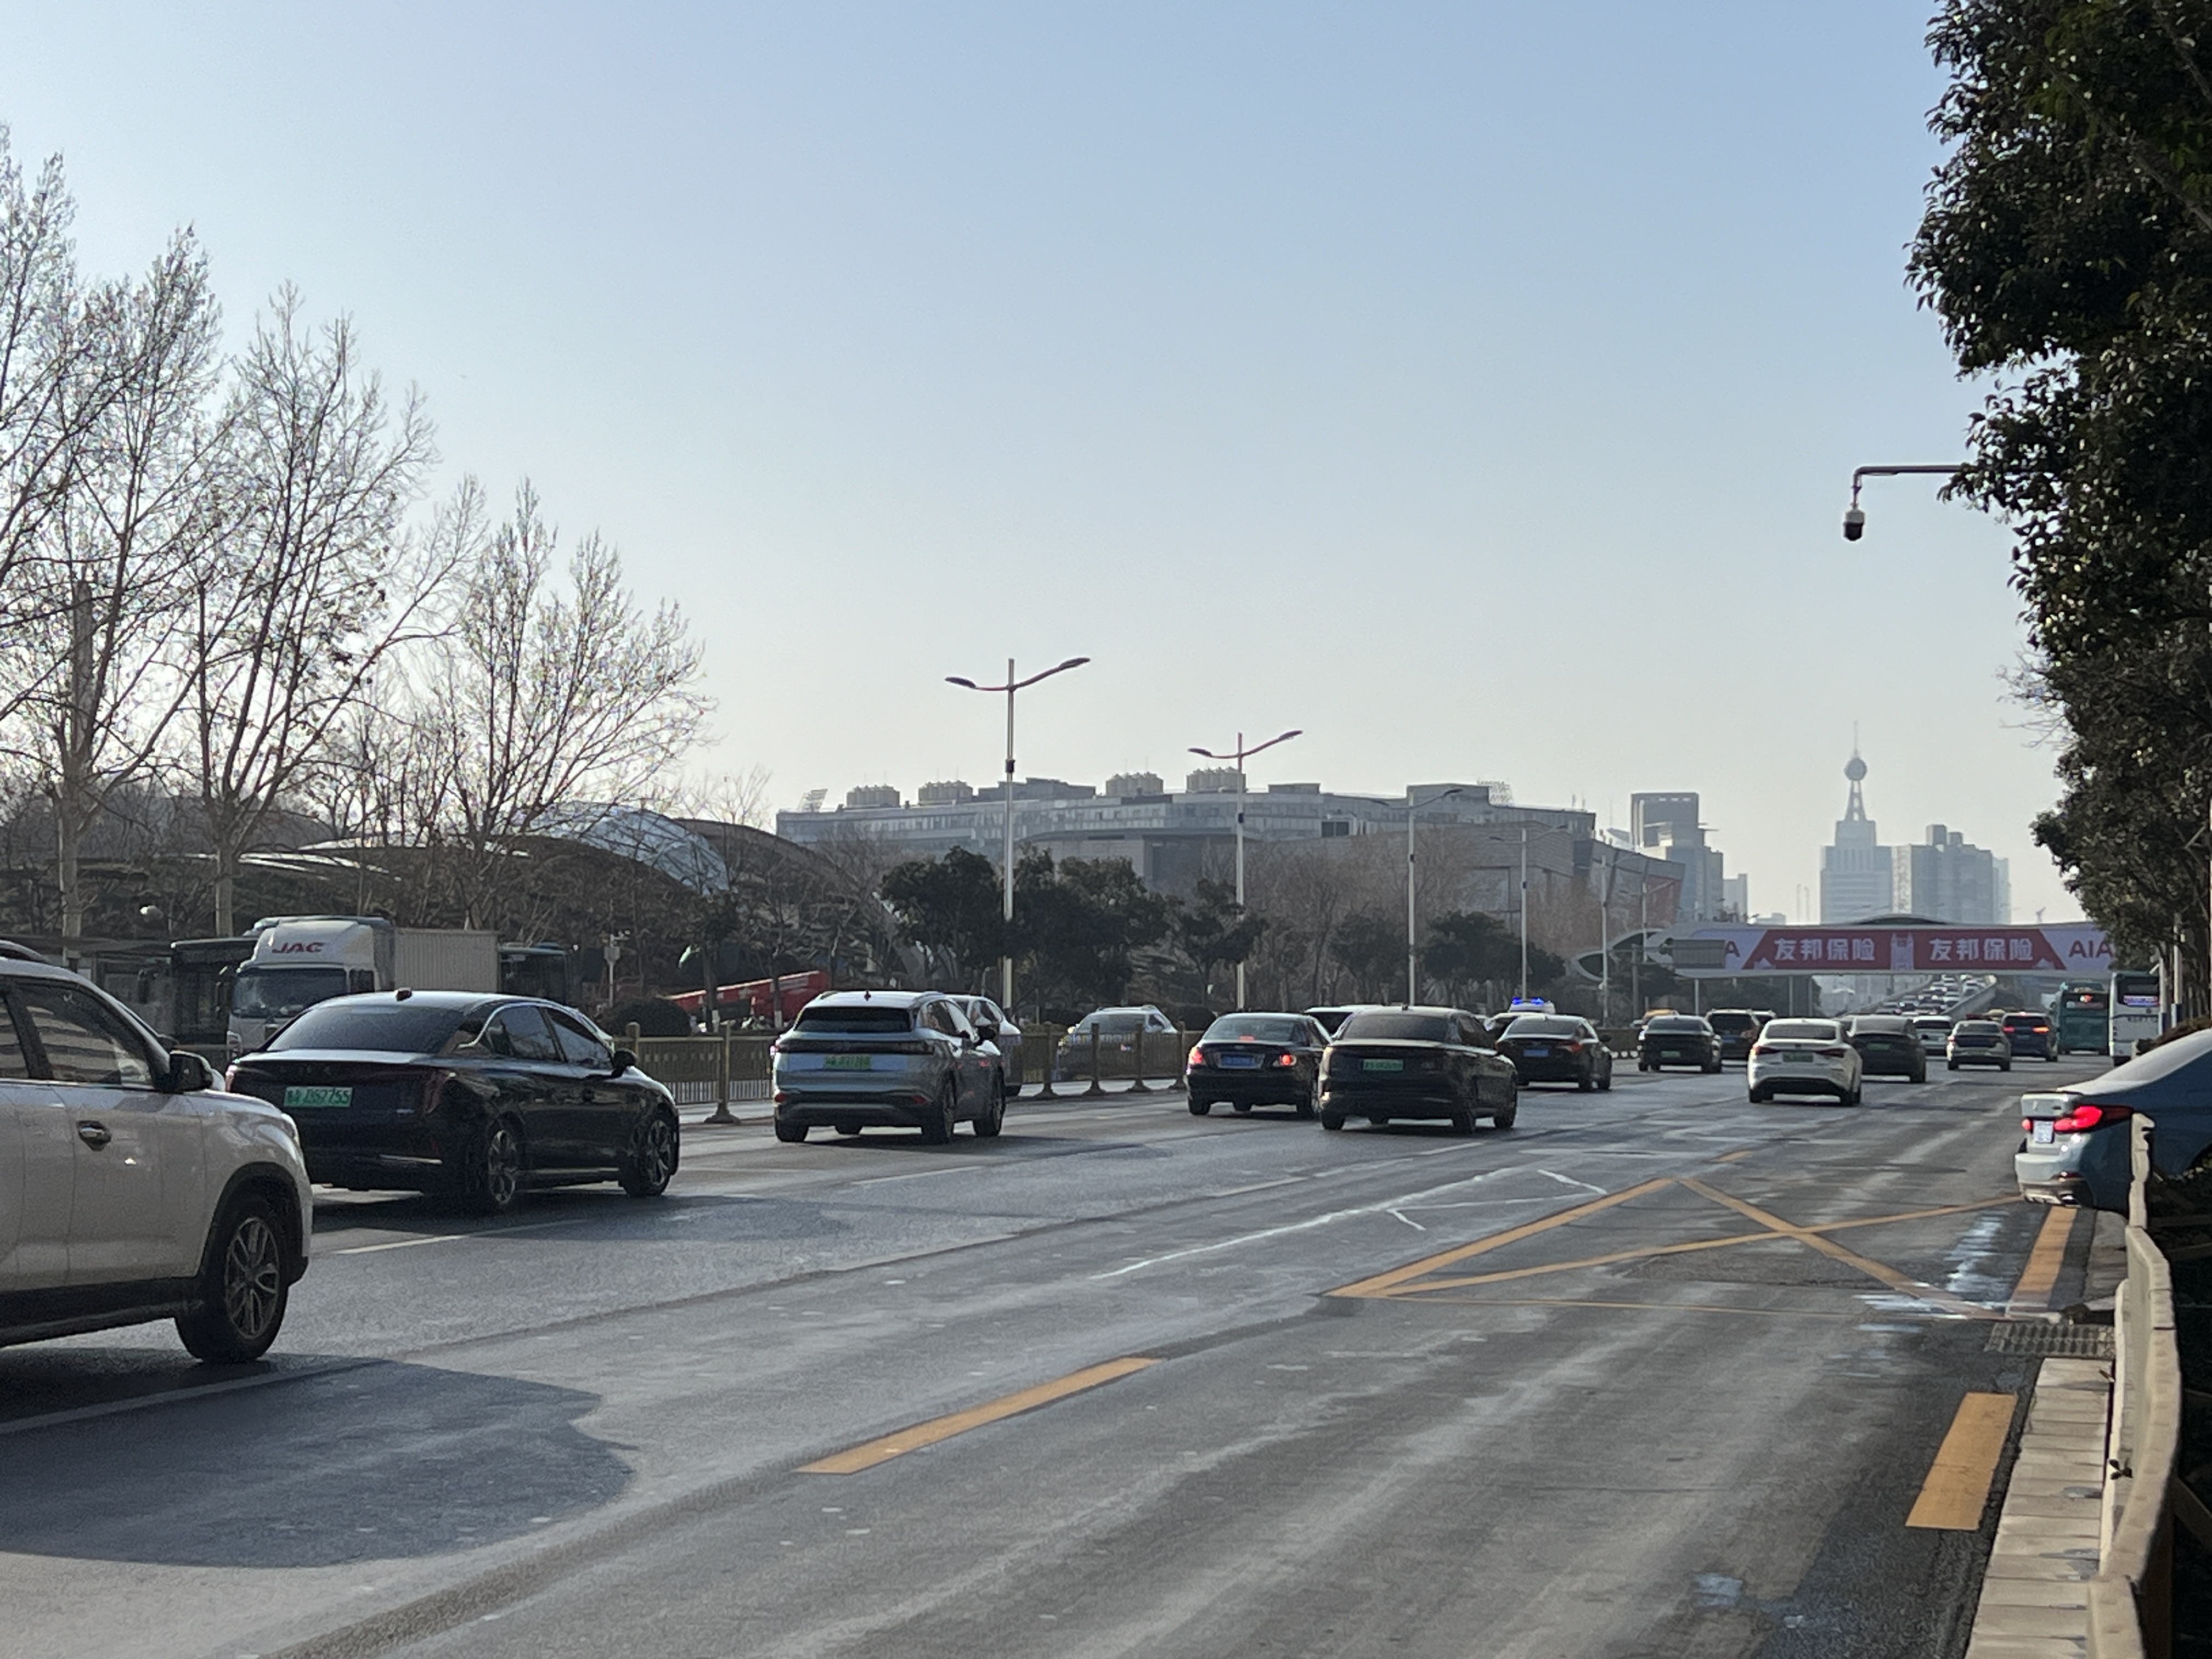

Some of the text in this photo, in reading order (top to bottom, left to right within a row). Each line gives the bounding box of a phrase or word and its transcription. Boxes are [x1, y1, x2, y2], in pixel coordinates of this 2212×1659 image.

[272, 942, 325, 953] JAC
[1774, 938, 1875, 961] 友邦保险
[1929, 938, 2033, 961] 友邦保险
[2068, 940, 2114, 958] AIA
